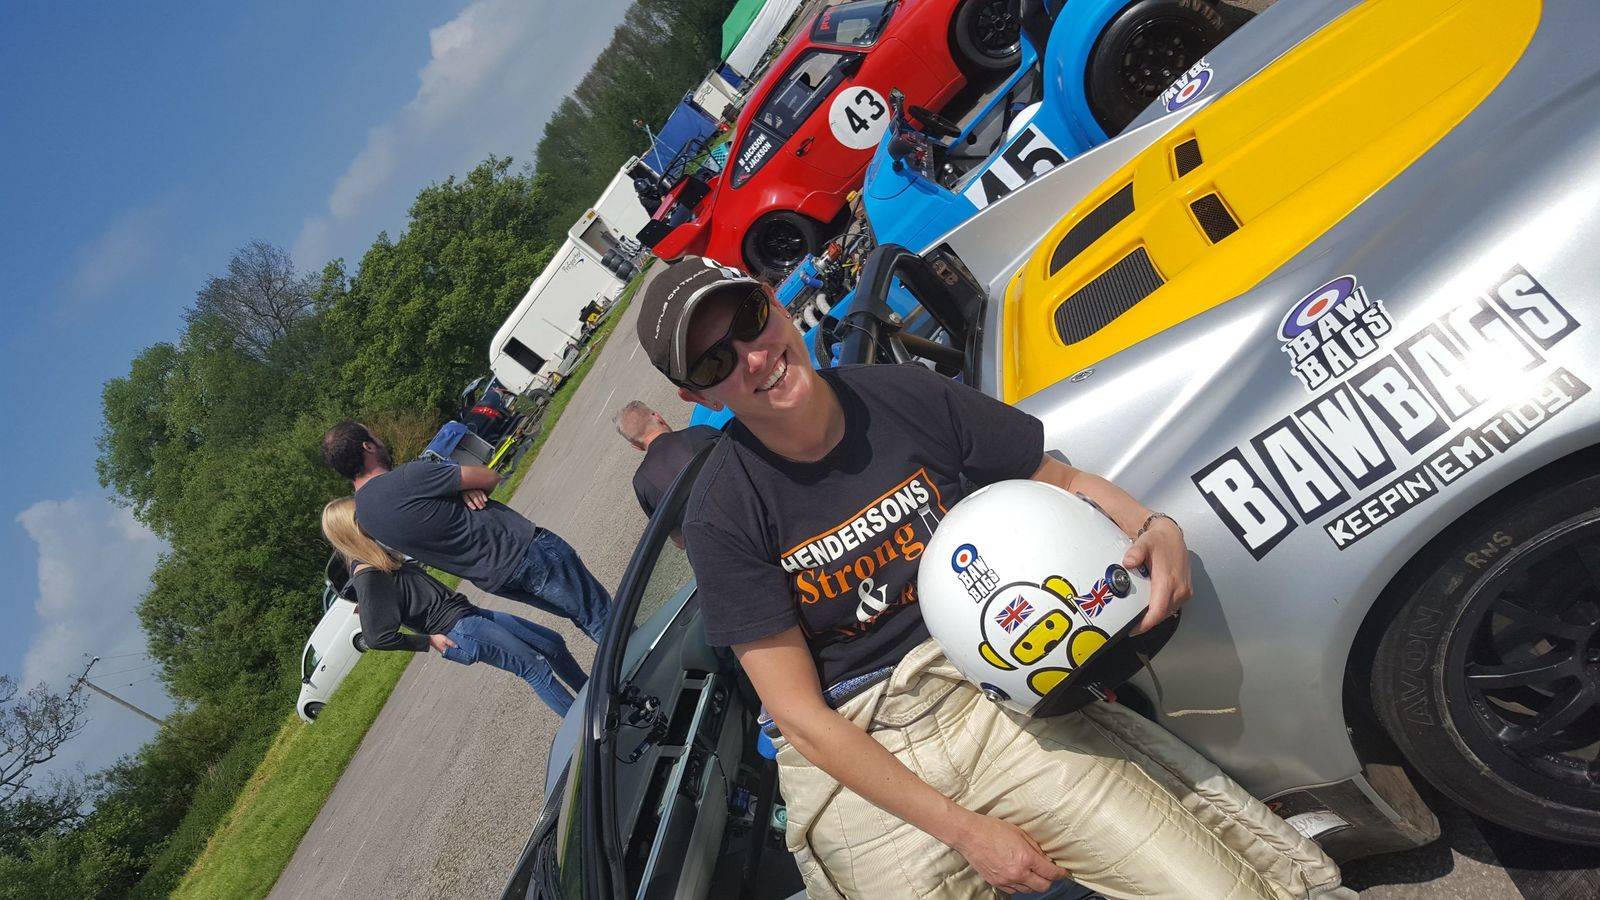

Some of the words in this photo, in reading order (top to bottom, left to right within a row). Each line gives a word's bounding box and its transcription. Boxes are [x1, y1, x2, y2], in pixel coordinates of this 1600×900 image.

[844, 89, 886, 135] 43
[744, 132, 767, 161] JACKSON
[744, 165, 751, 173] S
[749, 141, 772, 169] JACKSON
[667, 286, 680, 300] ON
[1288, 289, 1368, 362] BAW
[1295, 303, 1392, 390] BAGS
[781, 479, 930, 573] HENDERSONS
[796, 522, 926, 604] Strong
[958, 556, 989, 591] BAW
[856, 577, 890, 622] &
[1400, 606, 1444, 726] AVON
